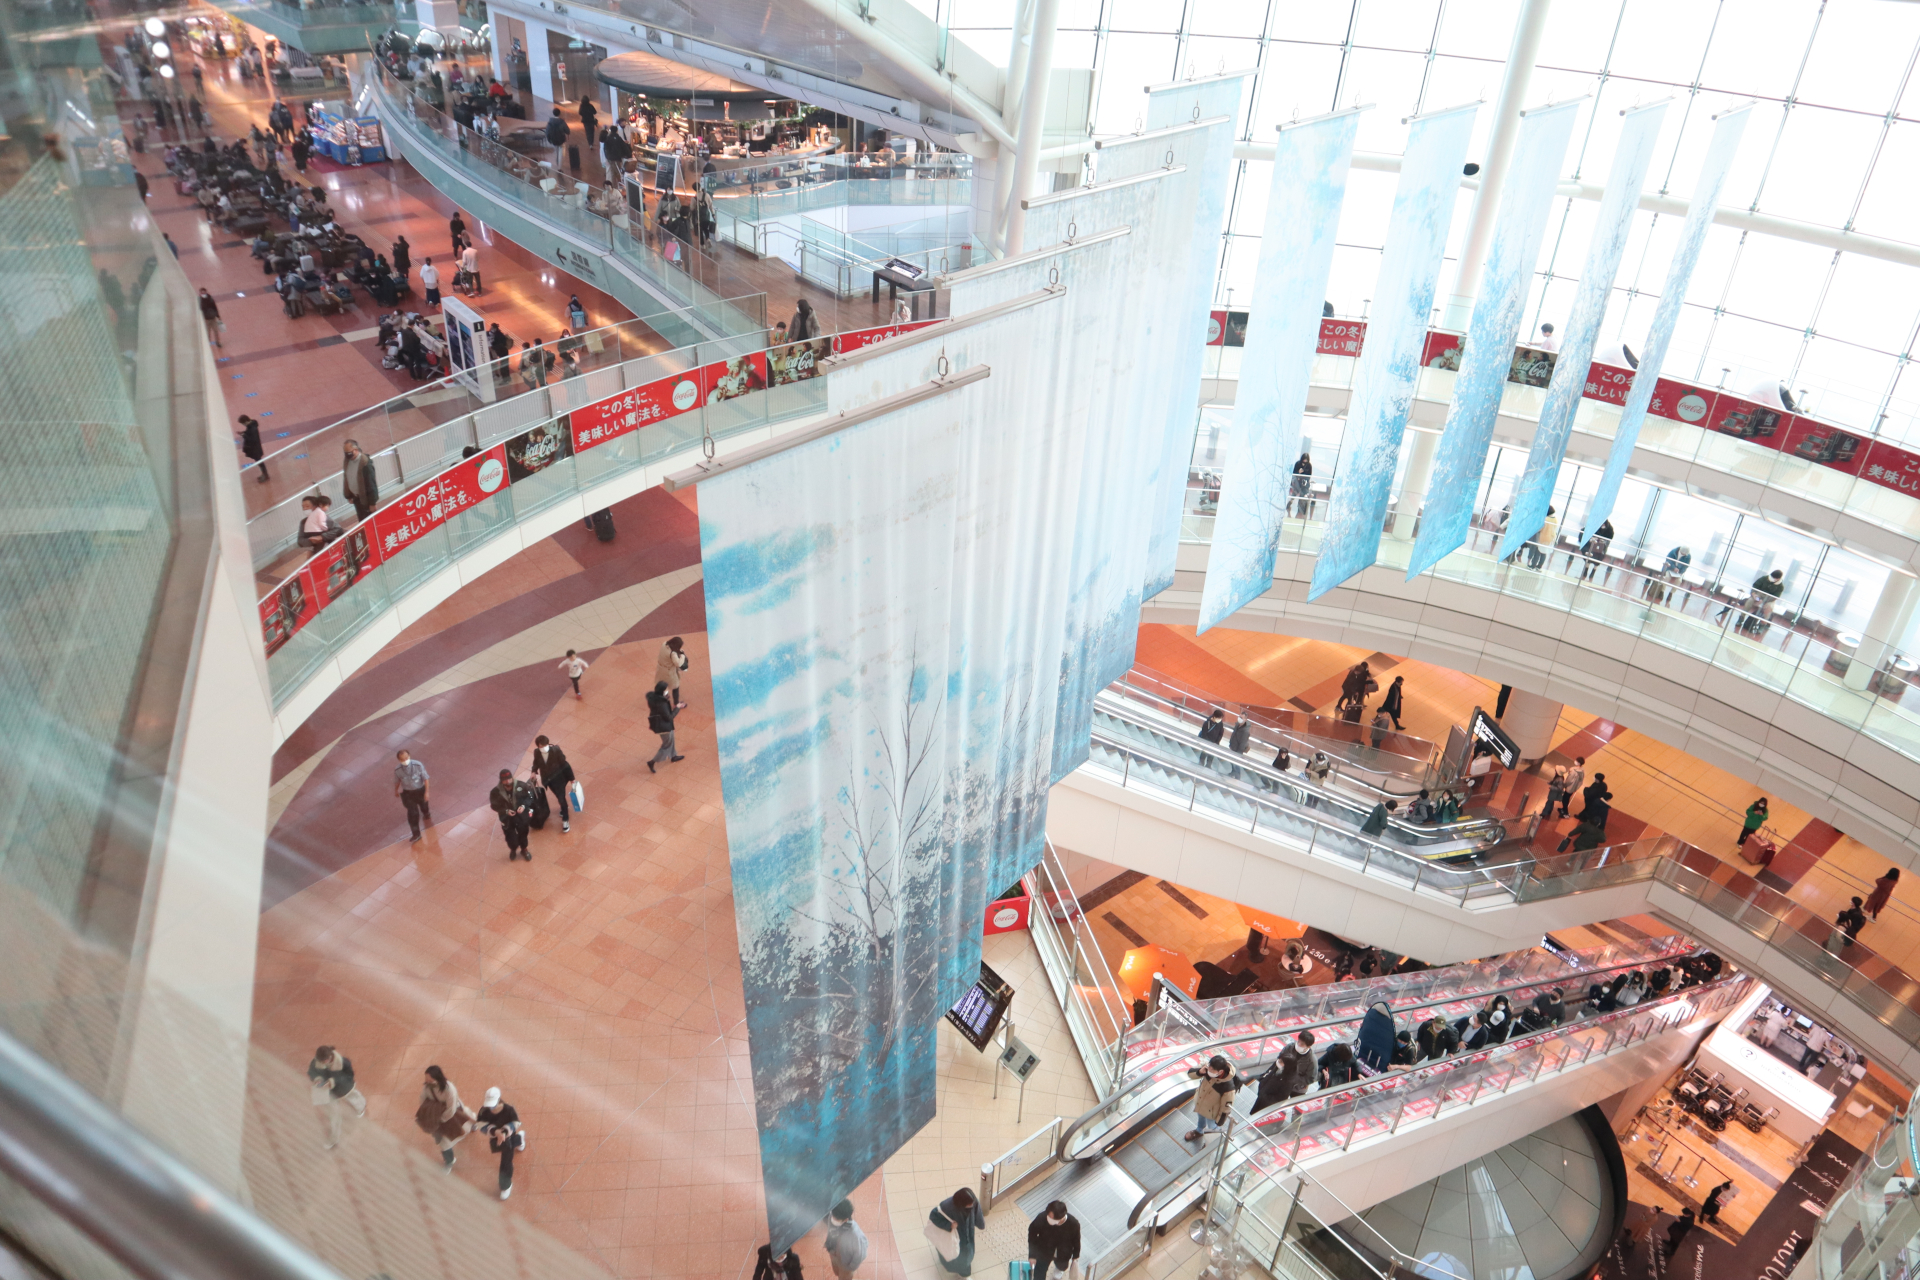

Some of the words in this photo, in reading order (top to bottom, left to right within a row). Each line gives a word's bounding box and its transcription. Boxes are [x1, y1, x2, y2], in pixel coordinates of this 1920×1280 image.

[673, 388, 696, 402] Coca-Cola
[601, 391, 653, 418] この冬に、
[1678, 402, 1704, 414] Coca-Cola
[578, 403, 666, 446] 美味しい魔法を。
[479, 468, 502, 486] Coca-Cola
[405, 479, 458, 516] この冬に、
[384, 490, 473, 551] 美味しい魔法を。
[994, 914, 1016, 922] Coca-Cola
[1253, 920, 1272, 932] me
[1309, 948, 1325, 960] 250
[1125, 956, 1135, 970] me
